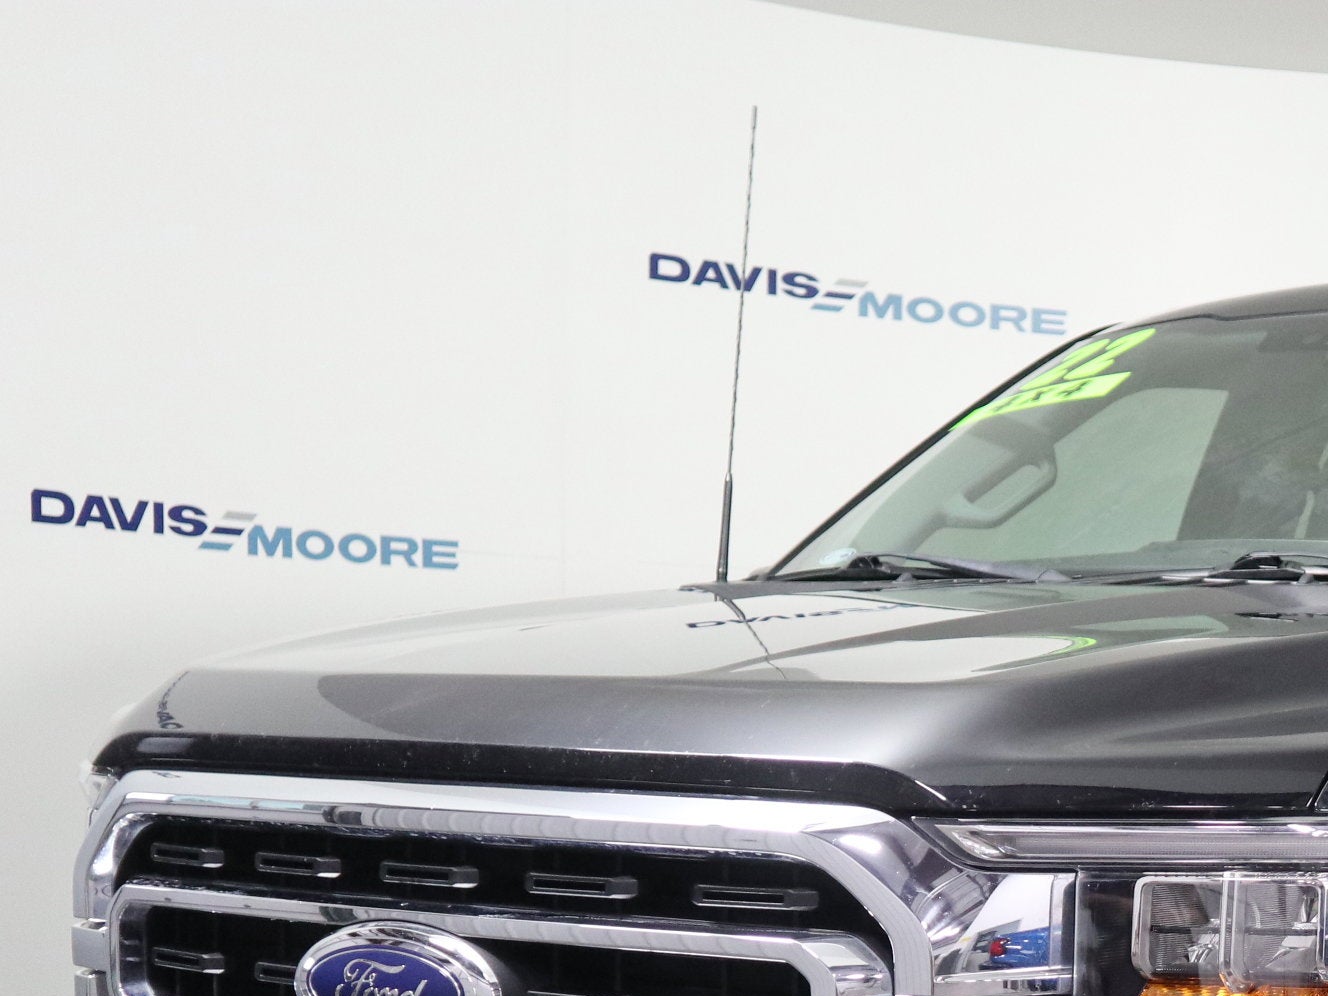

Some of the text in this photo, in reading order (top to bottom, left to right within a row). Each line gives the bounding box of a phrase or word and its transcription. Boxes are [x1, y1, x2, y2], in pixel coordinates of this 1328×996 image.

[648, 252, 1068, 336] DAVIS MOORE
[30, 488, 459, 570] DAVIS MOORE
